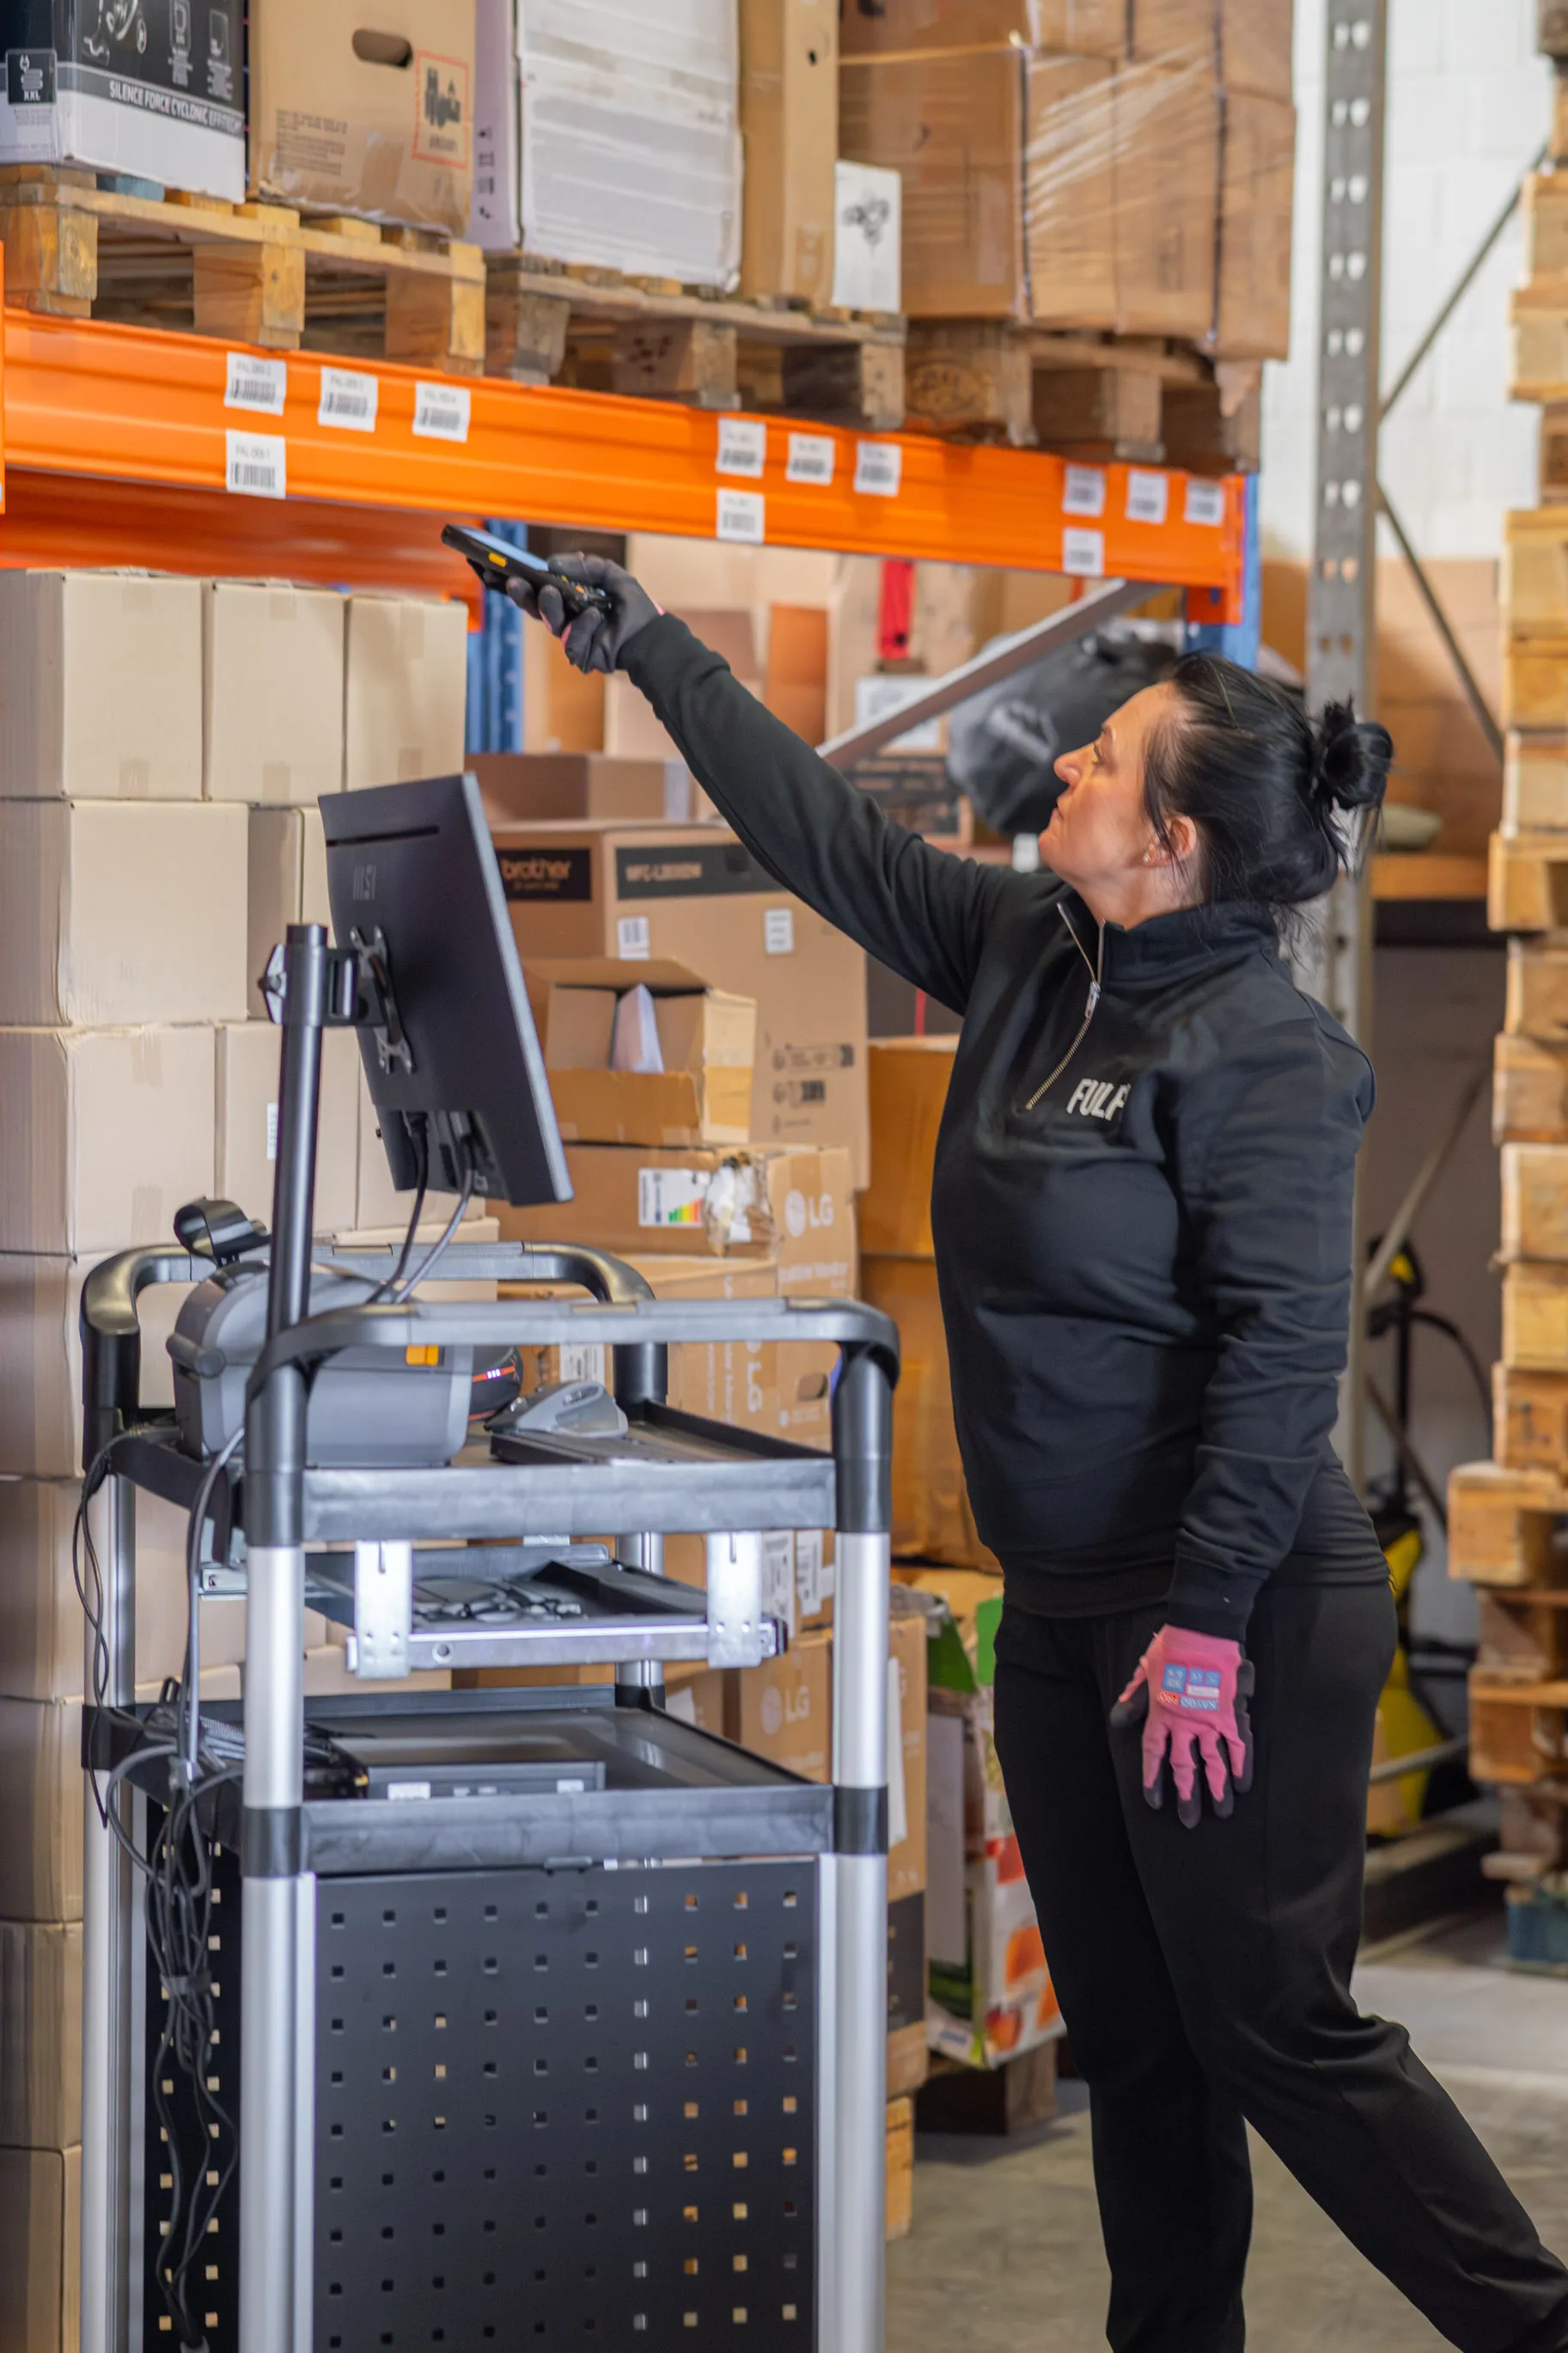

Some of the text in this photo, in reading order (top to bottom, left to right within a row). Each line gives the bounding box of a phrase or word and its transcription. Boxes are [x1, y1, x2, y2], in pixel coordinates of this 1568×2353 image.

[109, 80, 143, 106] SILENCE
[144, 89, 171, 113] FORCE
[501, 857, 571, 880] brother
[808, 1192, 834, 1227] LG
[747, 1361, 762, 1413] LG
[784, 1685, 810, 1722] LG
